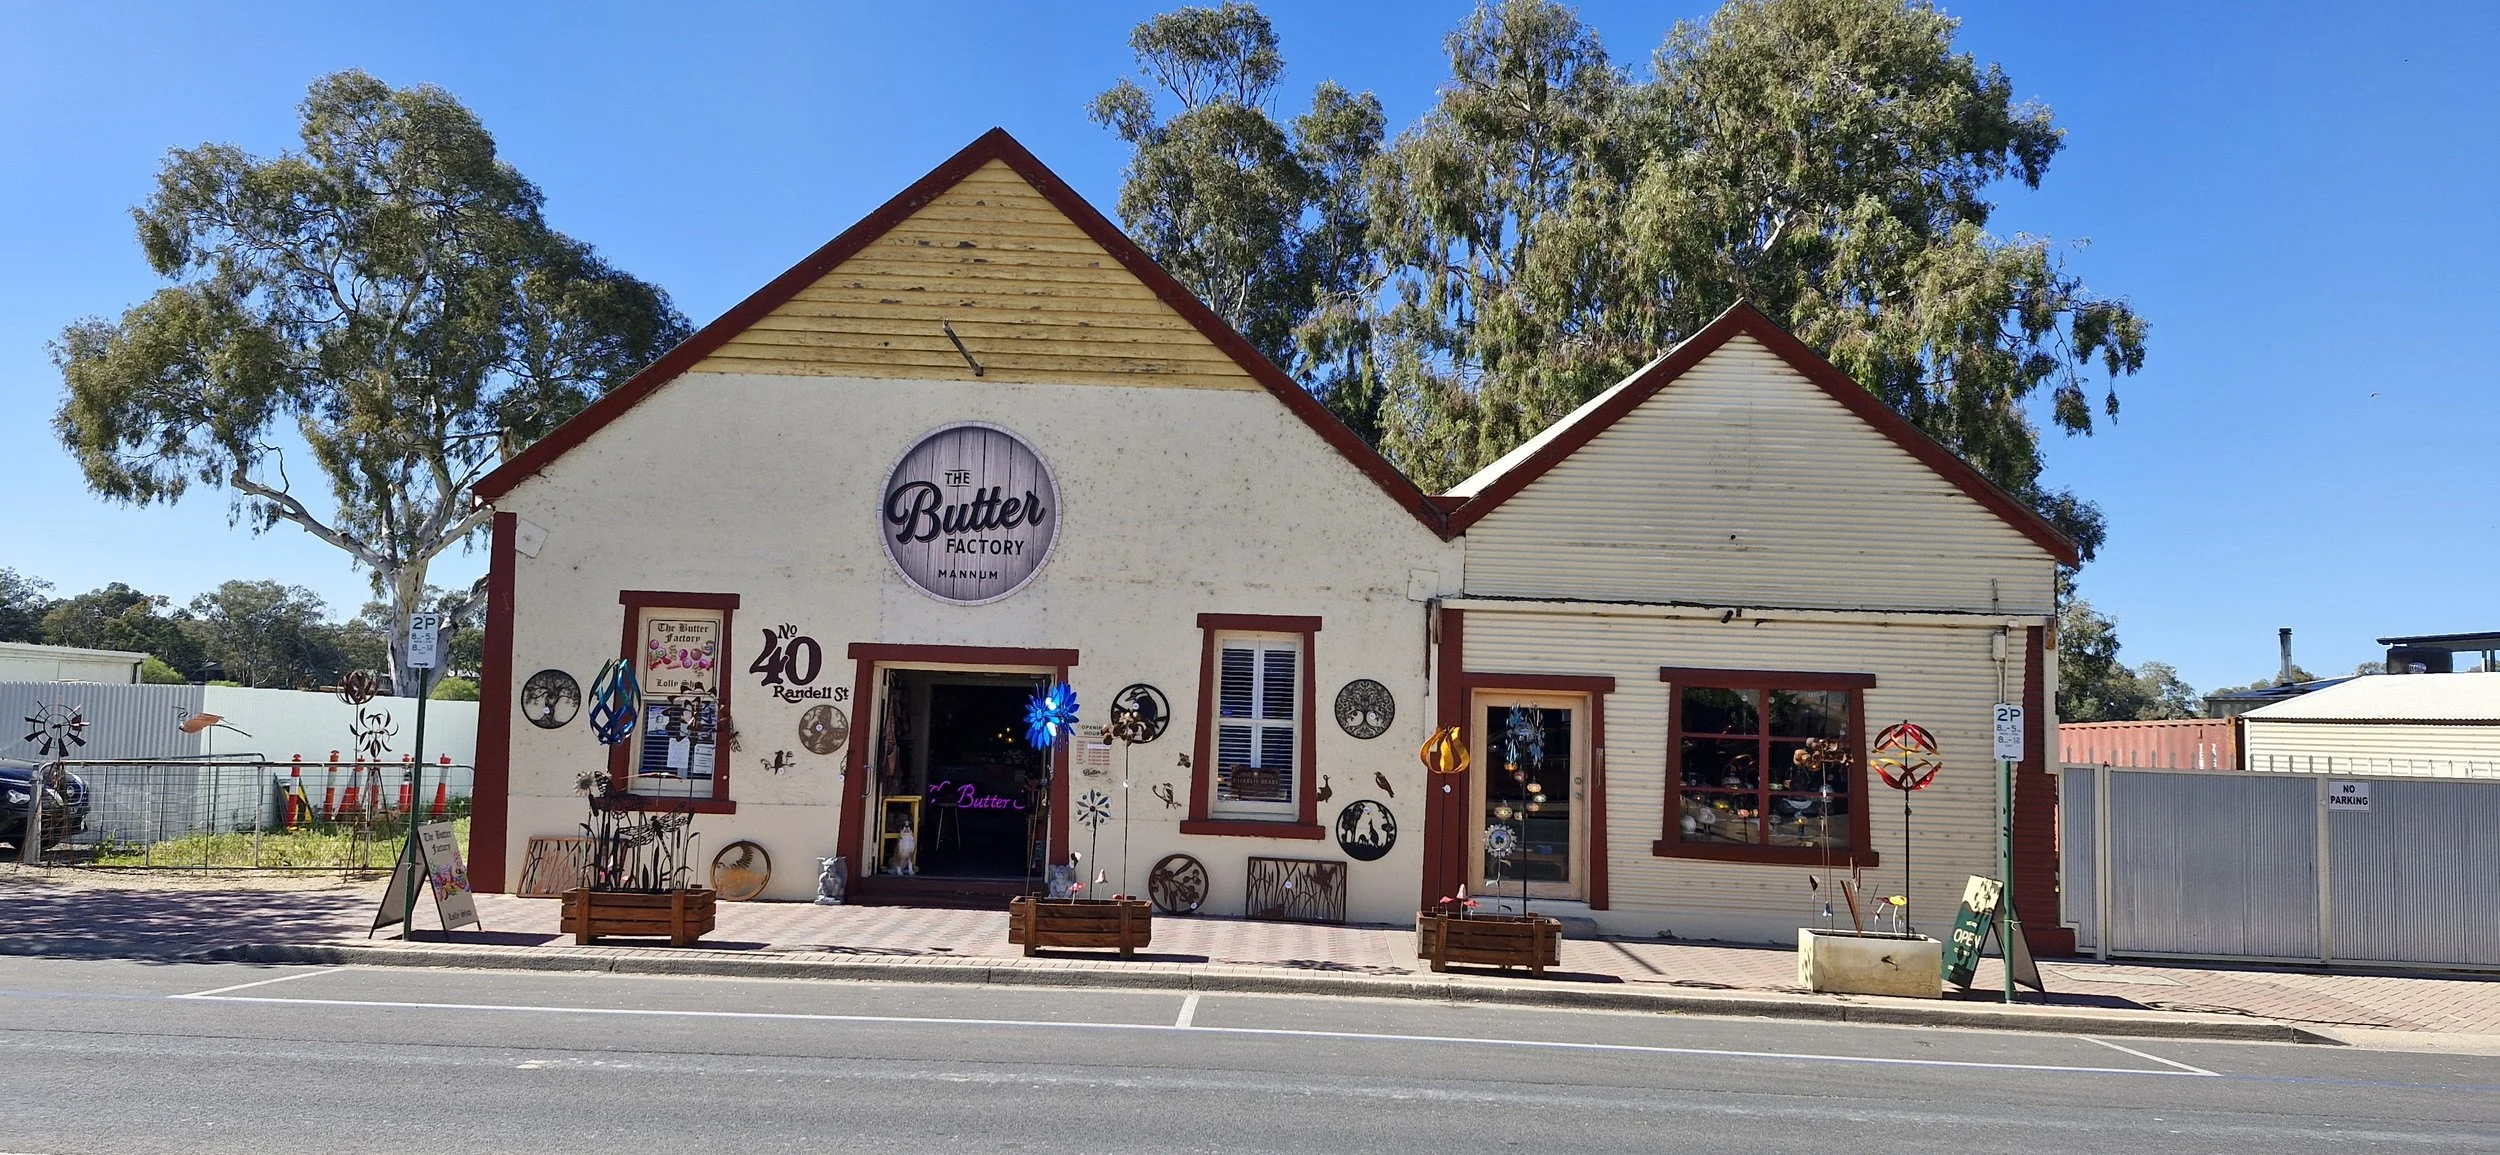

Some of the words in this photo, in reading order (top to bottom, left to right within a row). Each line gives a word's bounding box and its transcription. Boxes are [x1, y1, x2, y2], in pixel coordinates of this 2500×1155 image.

[945, 472, 970, 484] THE
[885, 481, 1046, 545] Butter
[946, 538, 1024, 556] FACTORY
[938, 569, 998, 580] MANNUM
[412, 616, 436, 630] 2P
[657, 622, 676, 632] The
[679, 622, 709, 632] Butter
[664, 633, 701, 643] Factory
[749, 628, 822, 687] 40
[656, 678, 679, 687] Lolly
[773, 685, 832, 704] Randell
[834, 687, 849, 702] St
[1997, 708, 2021, 721] 2P
[2343, 785, 2355, 793] NO
[957, 783, 1011, 809] Butter
[2330, 796, 2368, 805] PARKING
[1953, 928, 1982, 949] OPEN
